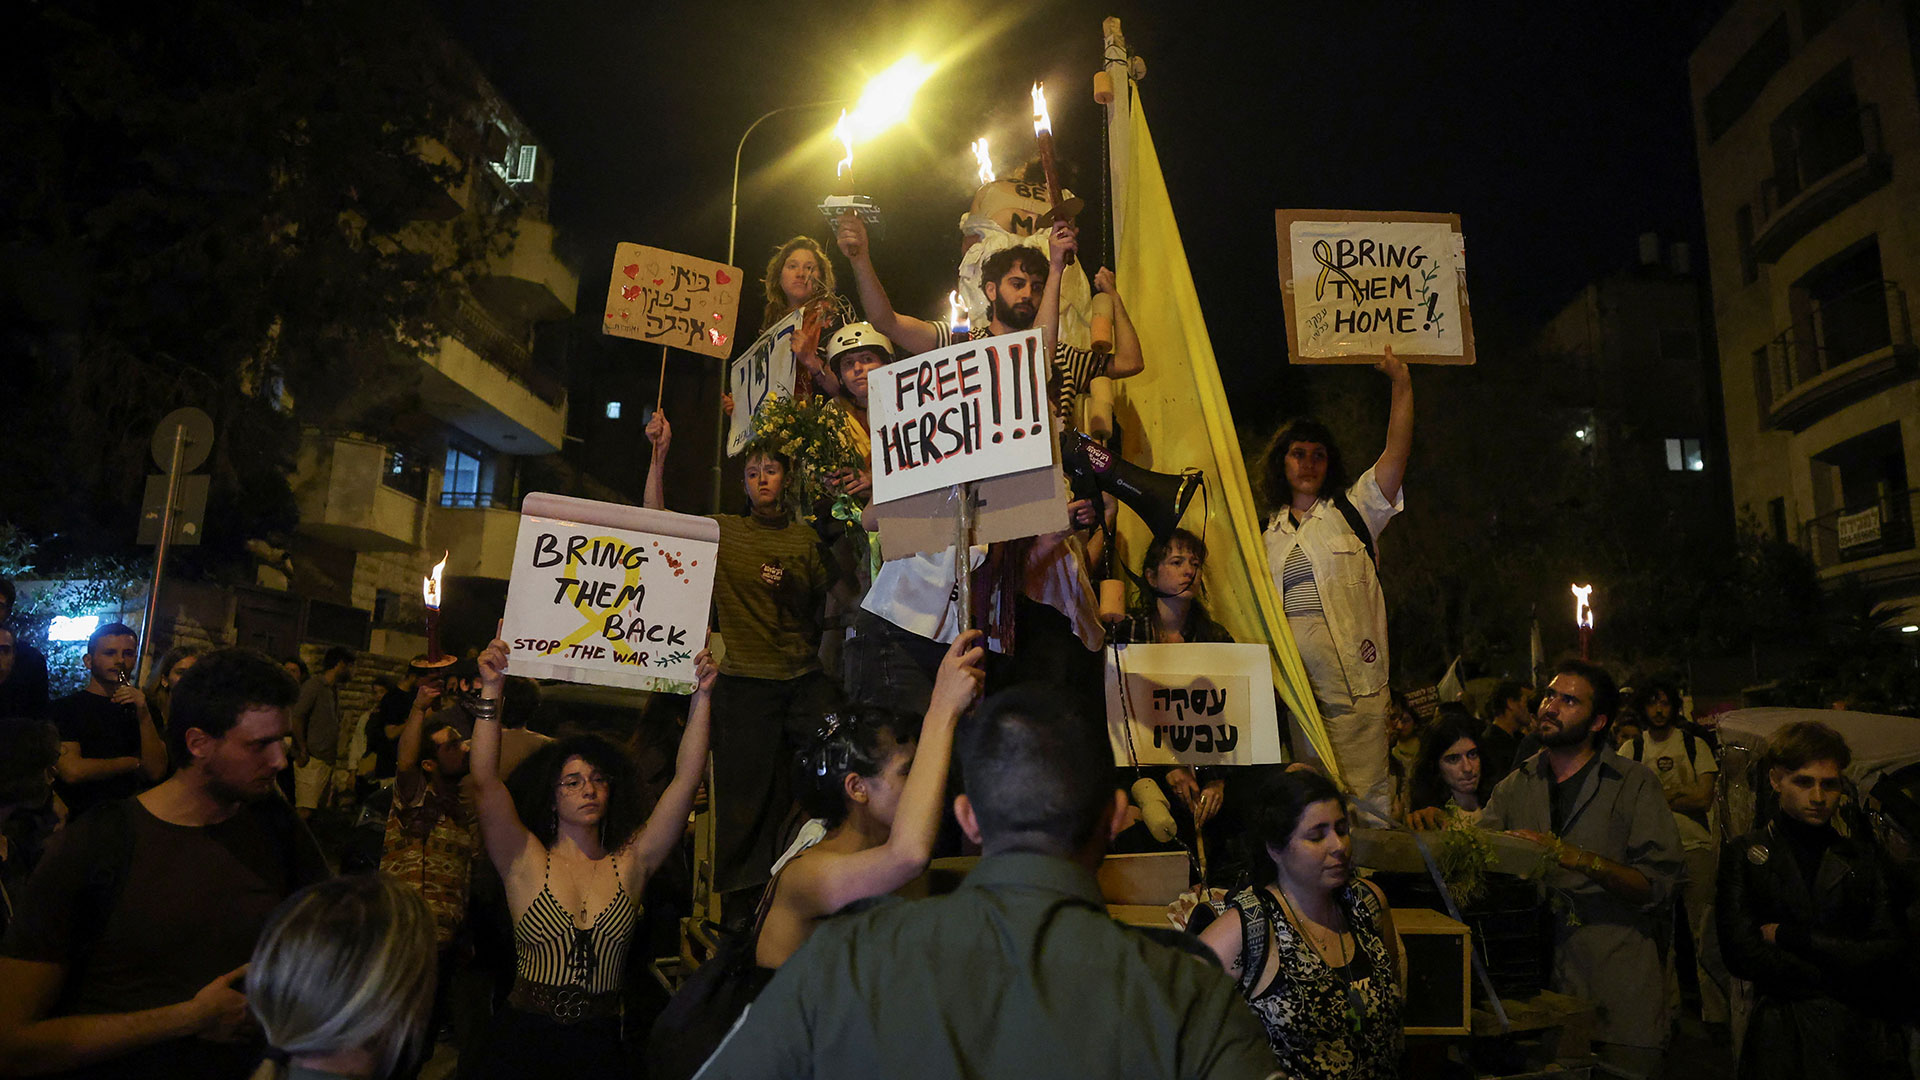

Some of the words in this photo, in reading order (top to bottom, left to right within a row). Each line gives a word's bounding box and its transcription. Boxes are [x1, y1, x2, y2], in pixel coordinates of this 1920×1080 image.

[1336, 239, 1428, 269] BRING
[670, 265, 710, 292] בואי
[1328, 274, 1413, 301] THEM
[642, 287, 691, 315] נפגין
[1335, 292, 1438, 334] HOME!
[645, 314, 705, 346] אהבה
[896, 350, 982, 411] FREE
[533, 533, 649, 570] BRING
[554, 577, 645, 612] THEM
[602, 614, 687, 646] BACK
[514, 639, 560, 655] STOP
[569, 644, 605, 660] THE
[613, 651, 650, 667] WAR
[1153, 688, 1227, 720] עסקה
[1153, 724, 1238, 753] עכשיו
